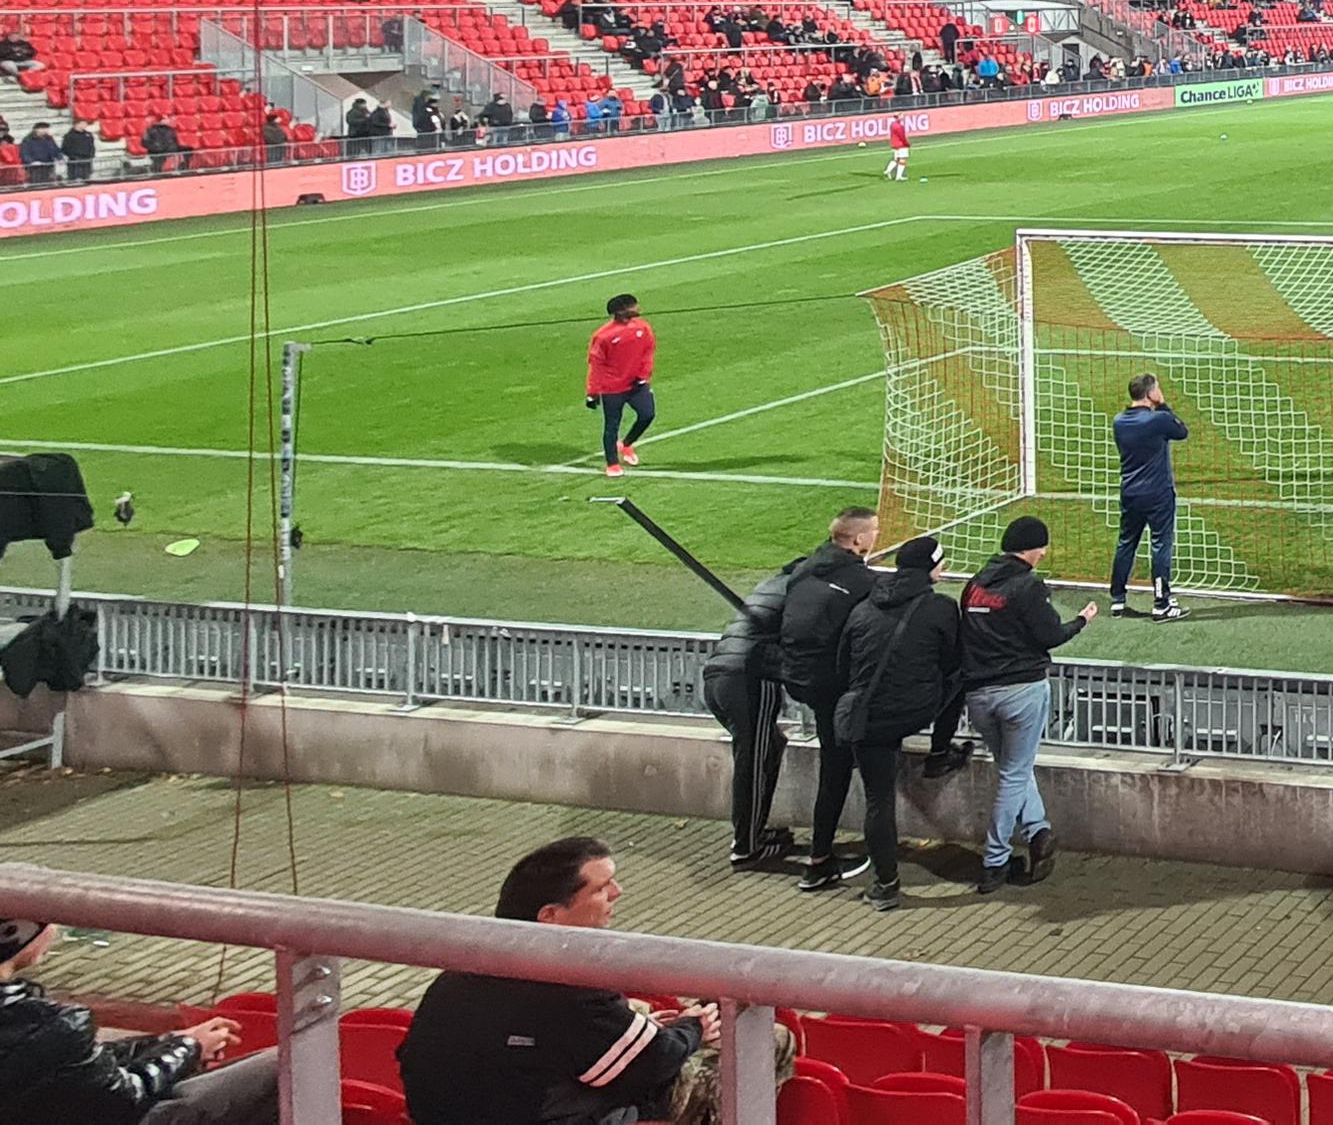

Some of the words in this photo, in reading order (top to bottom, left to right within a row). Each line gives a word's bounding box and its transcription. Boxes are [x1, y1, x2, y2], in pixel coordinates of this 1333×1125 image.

[1180, 88, 1226, 104] Chance
[1227, 84, 1253, 99] LIGA
[1284, 78, 1304, 92] BICZ
[1050, 99, 1080, 117] BICZ
[1083, 94, 1140, 114] HOLDING
[804, 121, 846, 143] BICZ
[396, 157, 465, 187] BICZ
[472, 145, 598, 178] HOLDING
